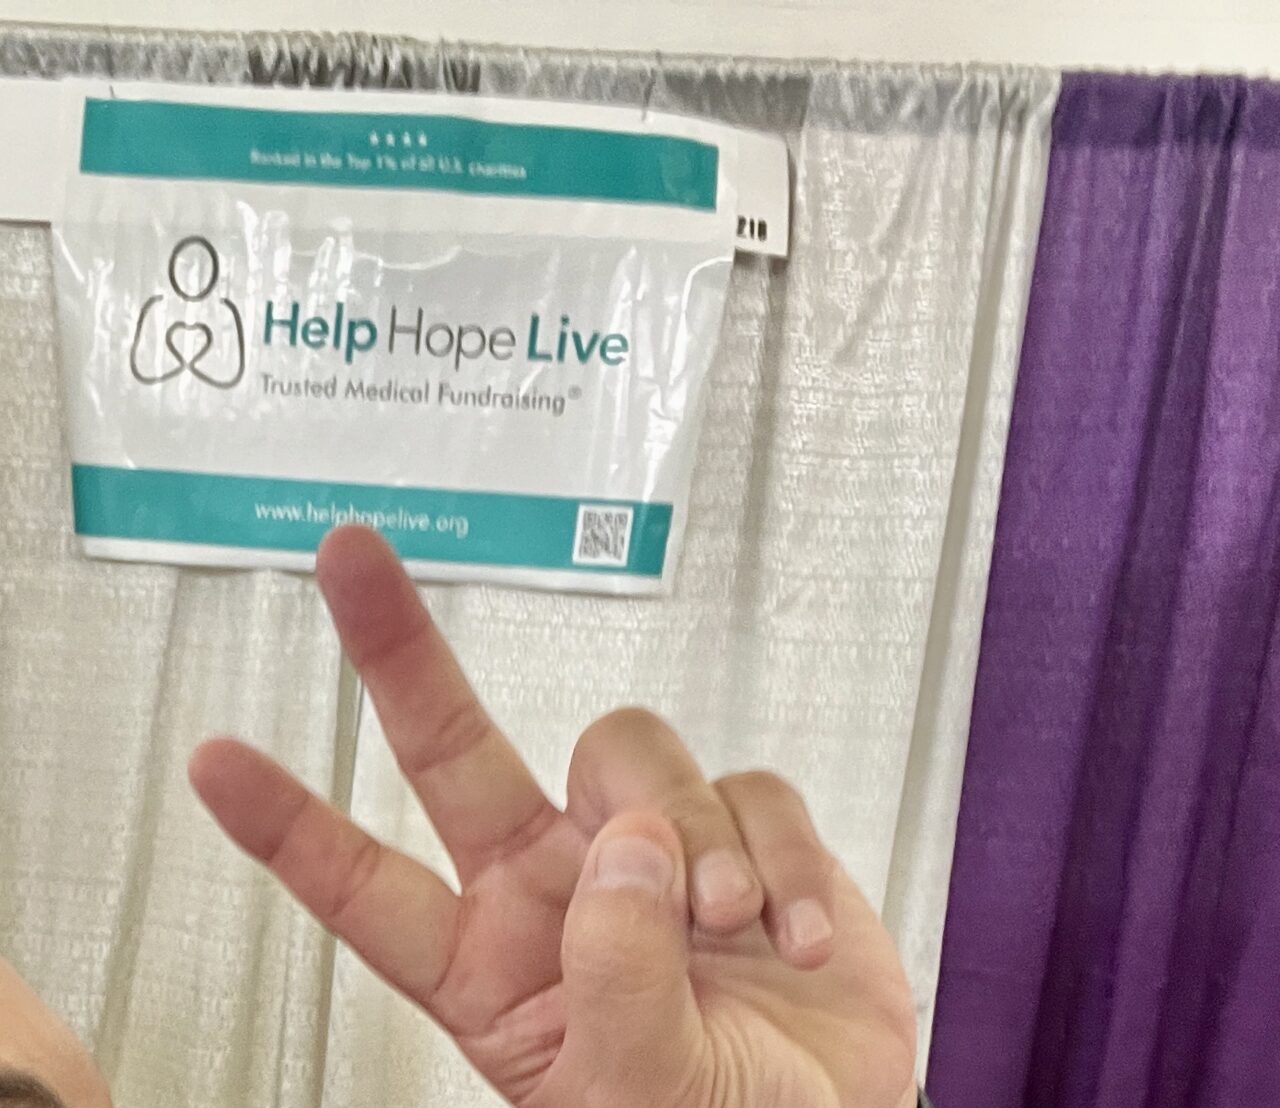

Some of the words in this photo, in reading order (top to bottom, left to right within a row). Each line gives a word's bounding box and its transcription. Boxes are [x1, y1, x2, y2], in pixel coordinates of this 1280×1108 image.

[264, 301, 378, 365] Help
[388, 304, 516, 372] Hope
[526, 312, 629, 366] Live
[262, 373, 338, 399] Trusted
[345, 380, 430, 405] Medical
[254, 500, 469, 539] www.helphopelive.org
